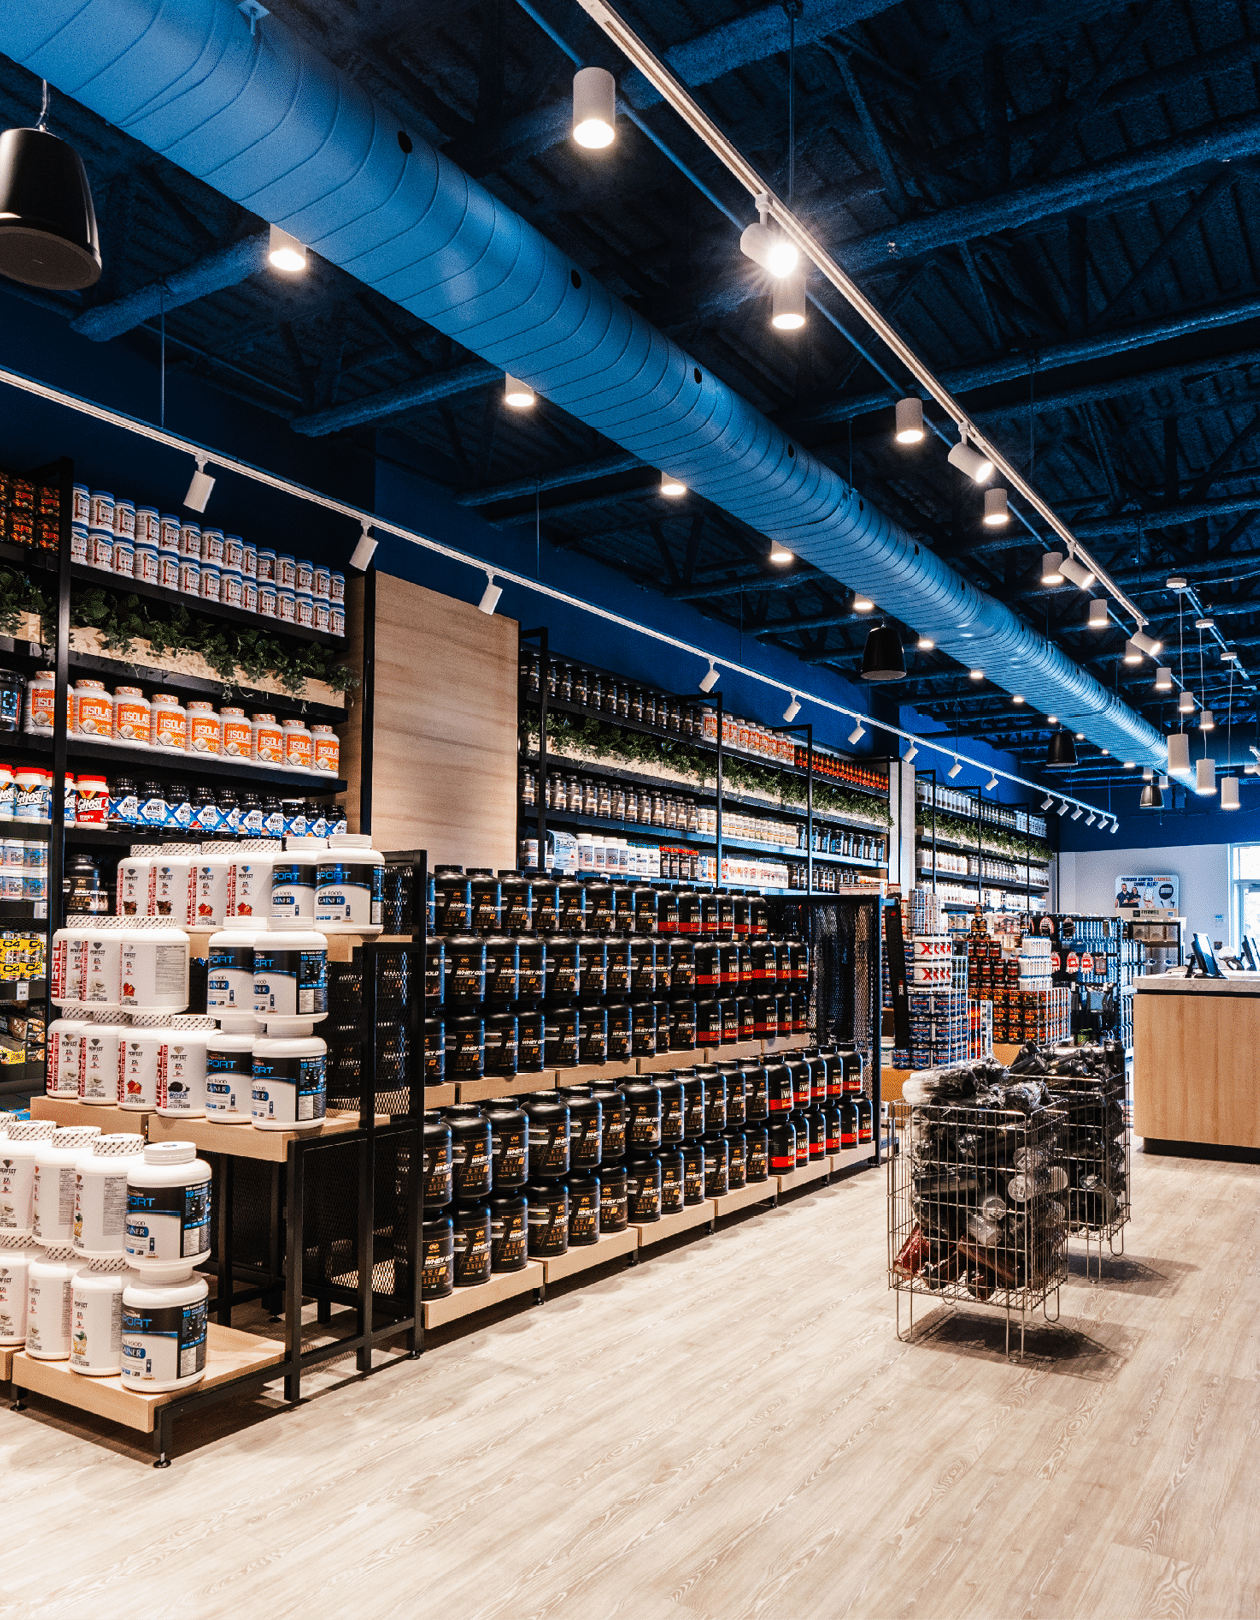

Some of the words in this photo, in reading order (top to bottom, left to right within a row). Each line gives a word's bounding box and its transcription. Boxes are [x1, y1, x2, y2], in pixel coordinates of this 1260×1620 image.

[16, 789, 47, 805] GHOST
[77, 797, 107, 812] GHOST
[272, 872, 300, 880] PORT
[316, 871, 351, 880] SPORT
[2, 940, 20, 948] C4
[3, 964, 20, 972] C4
[50, 940, 62, 998] DIESEL
[206, 1059, 237, 1069] PORT
[185, 1190, 195, 1198] 19
